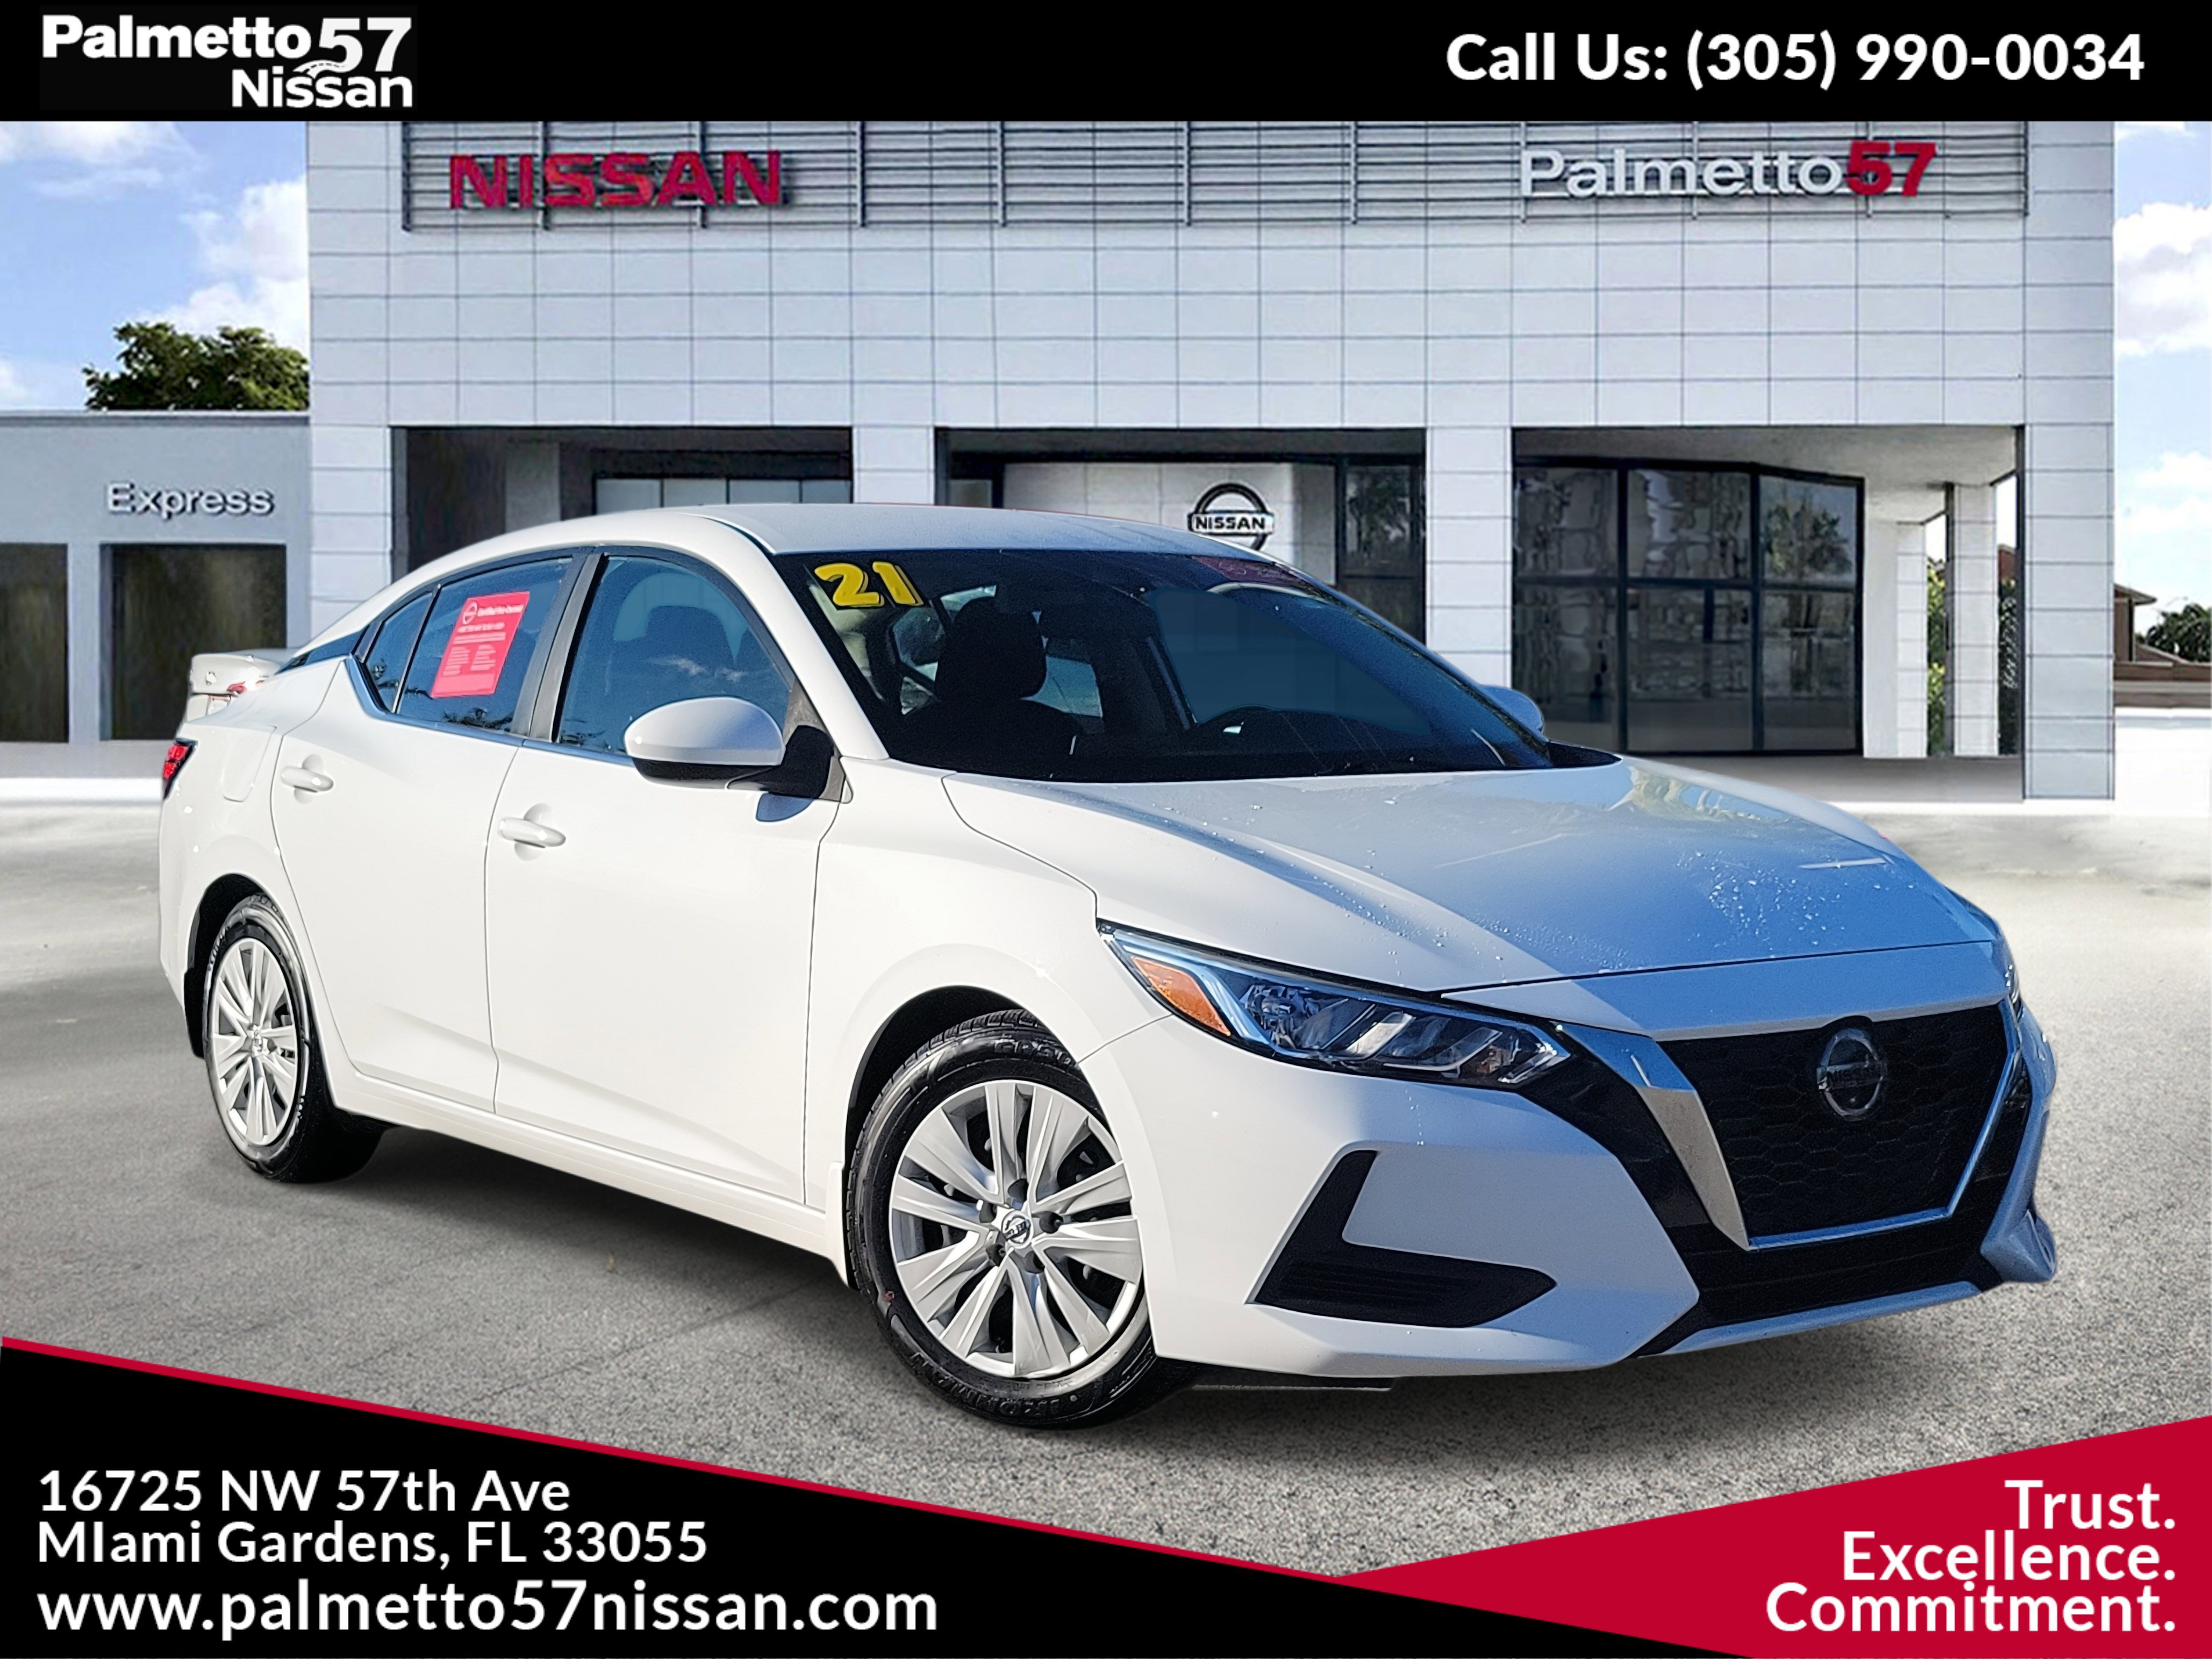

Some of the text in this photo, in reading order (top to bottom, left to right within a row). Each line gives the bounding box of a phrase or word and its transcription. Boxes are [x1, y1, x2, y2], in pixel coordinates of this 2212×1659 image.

[449, 151, 782, 209] NISSAN
[106, 482, 274, 519] Express
[1195, 516, 1265, 531] NISSAN
[814, 561, 924, 607] 21
